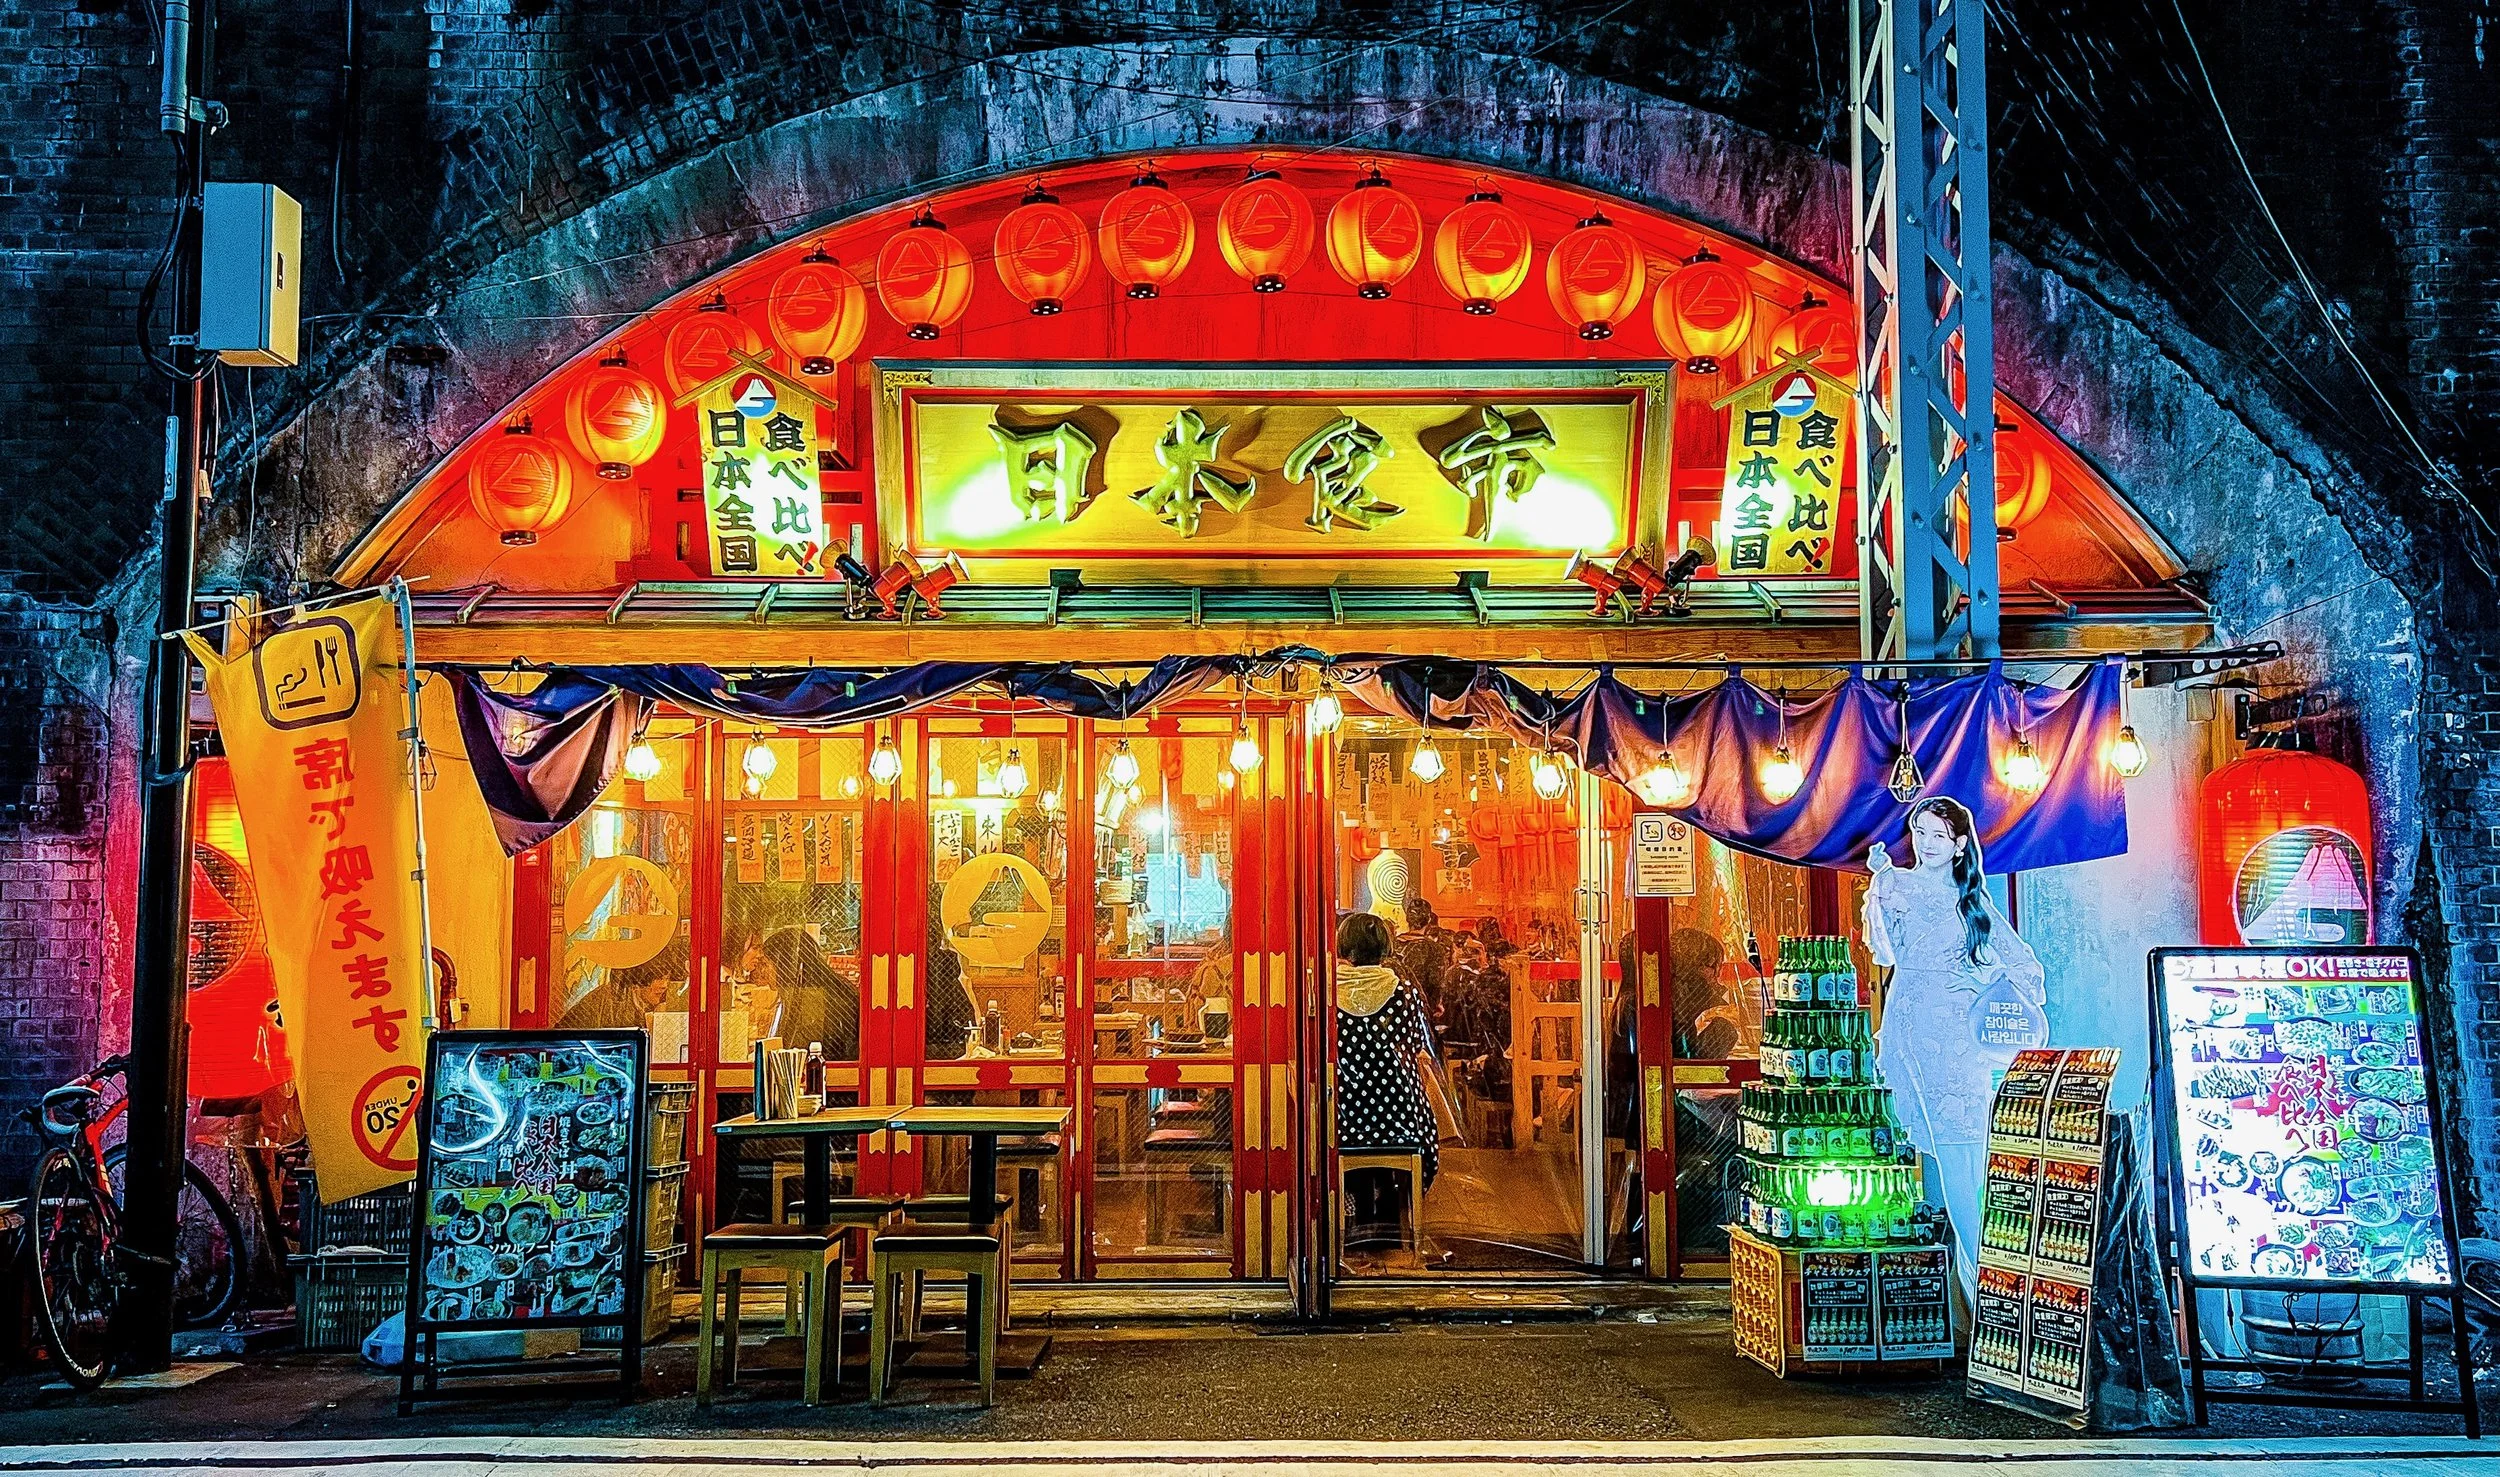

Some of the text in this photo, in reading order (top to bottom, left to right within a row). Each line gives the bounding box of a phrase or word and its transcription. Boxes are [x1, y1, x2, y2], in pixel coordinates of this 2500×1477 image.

[708, 409, 757, 572] 日本全国
[988, 404, 1556, 542] 日本食市
[1730, 409, 1781, 570] 日本全国
[947, 813, 961, 857] いぶりがこ
[2286, 958, 2337, 980] OK!
[1989, 1002, 2023, 1016] 깨끗한
[1980, 1030, 2035, 1045] 사랑입니다
[2305, 1053, 2339, 1151] 日本全国
[498, 1143, 514, 1173] 焼鳥
[533, 1113, 559, 1196] 日本全国
[558, 1116, 571, 1159] 焼きそば
[559, 1160, 579, 1181] 丼
[488, 1240, 557, 1255] ソウルフード
